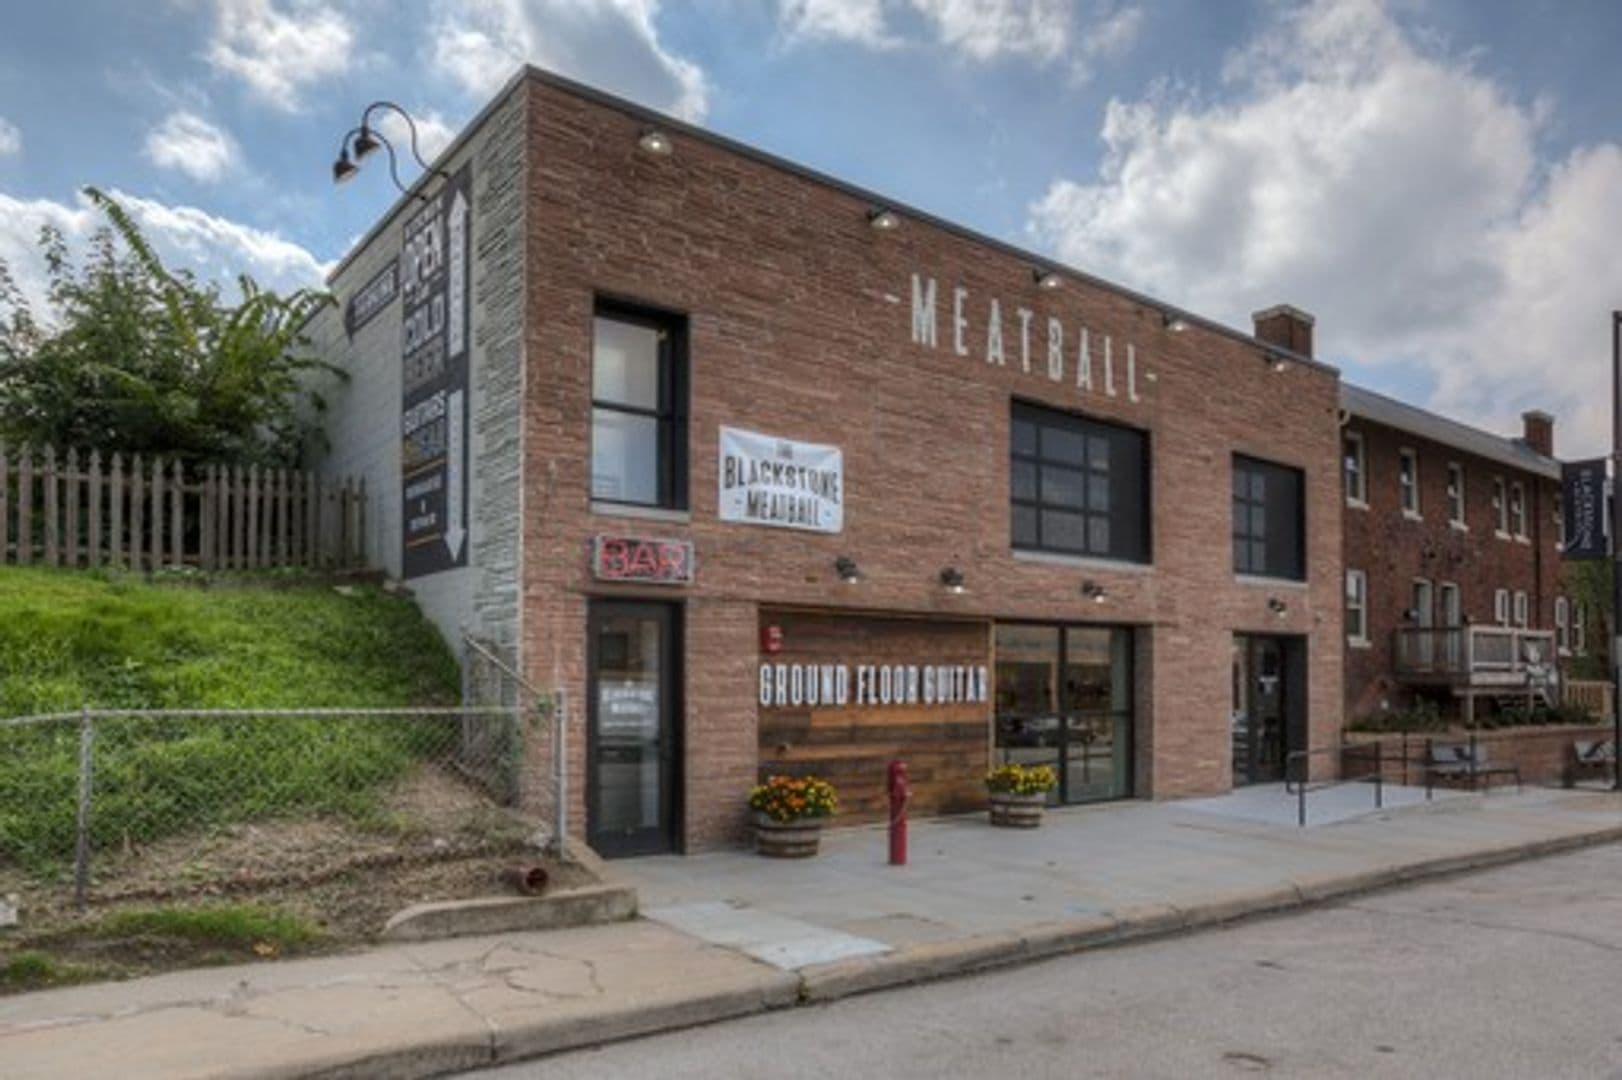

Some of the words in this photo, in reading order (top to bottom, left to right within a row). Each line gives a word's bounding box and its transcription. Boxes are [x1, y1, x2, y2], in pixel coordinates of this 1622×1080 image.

[911, 273, 1138, 403] MEATBALL
[724, 455, 840, 505] BLACKSTONE
[745, 490, 821, 526] MEATBALL
[601, 540, 686, 579] BAR
[760, 664, 848, 706] GROUND
[856, 664, 919, 705] FLOOR
